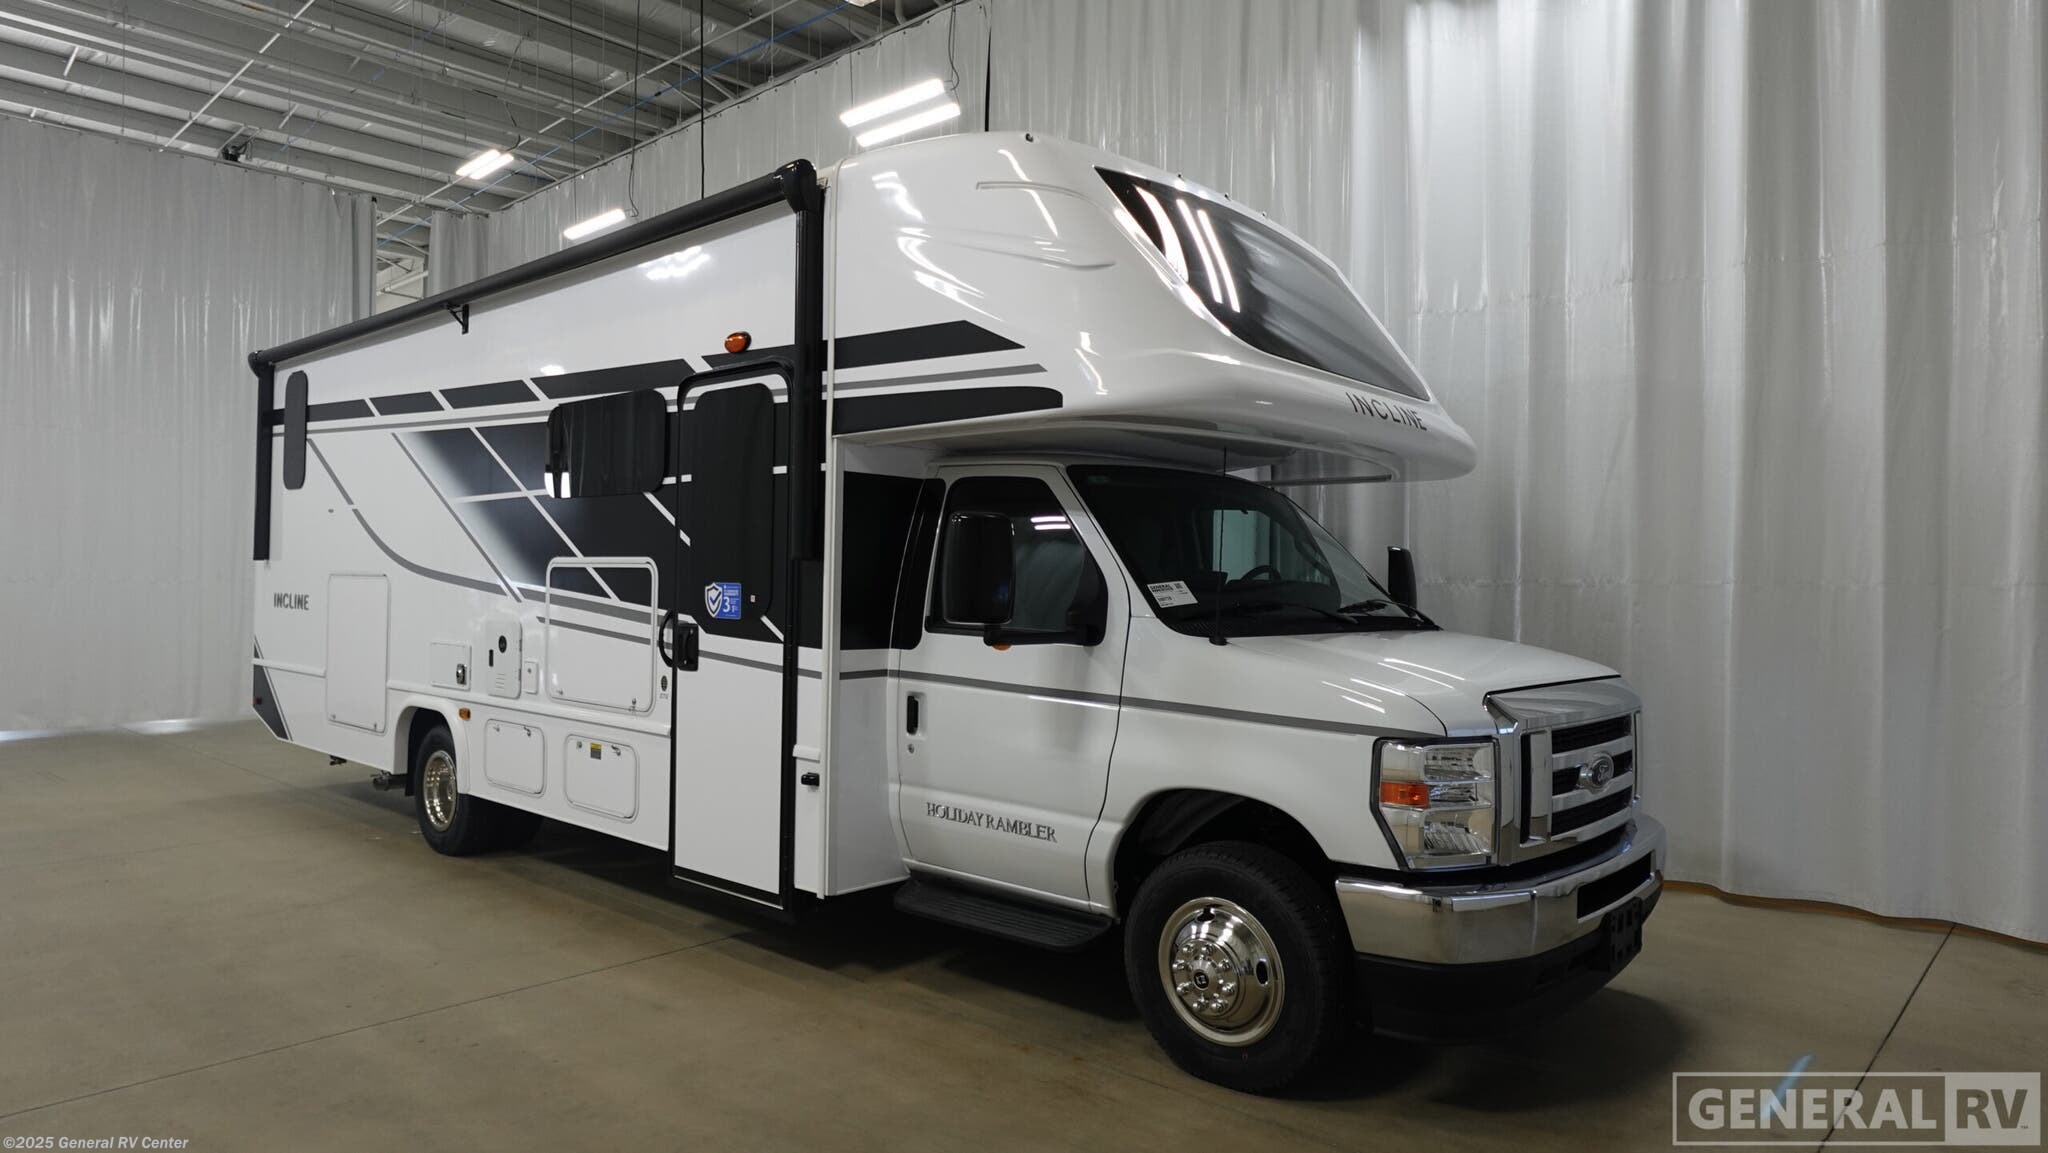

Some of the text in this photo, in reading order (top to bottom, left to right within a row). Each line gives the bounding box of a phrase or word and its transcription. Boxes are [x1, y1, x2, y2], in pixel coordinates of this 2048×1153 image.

[1345, 391, 1428, 431] INCLINE
[273, 592, 310, 611] INCLINE
[723, 596, 731, 612] 3
[926, 801, 1058, 843] HOLIDAY RAMBLER
